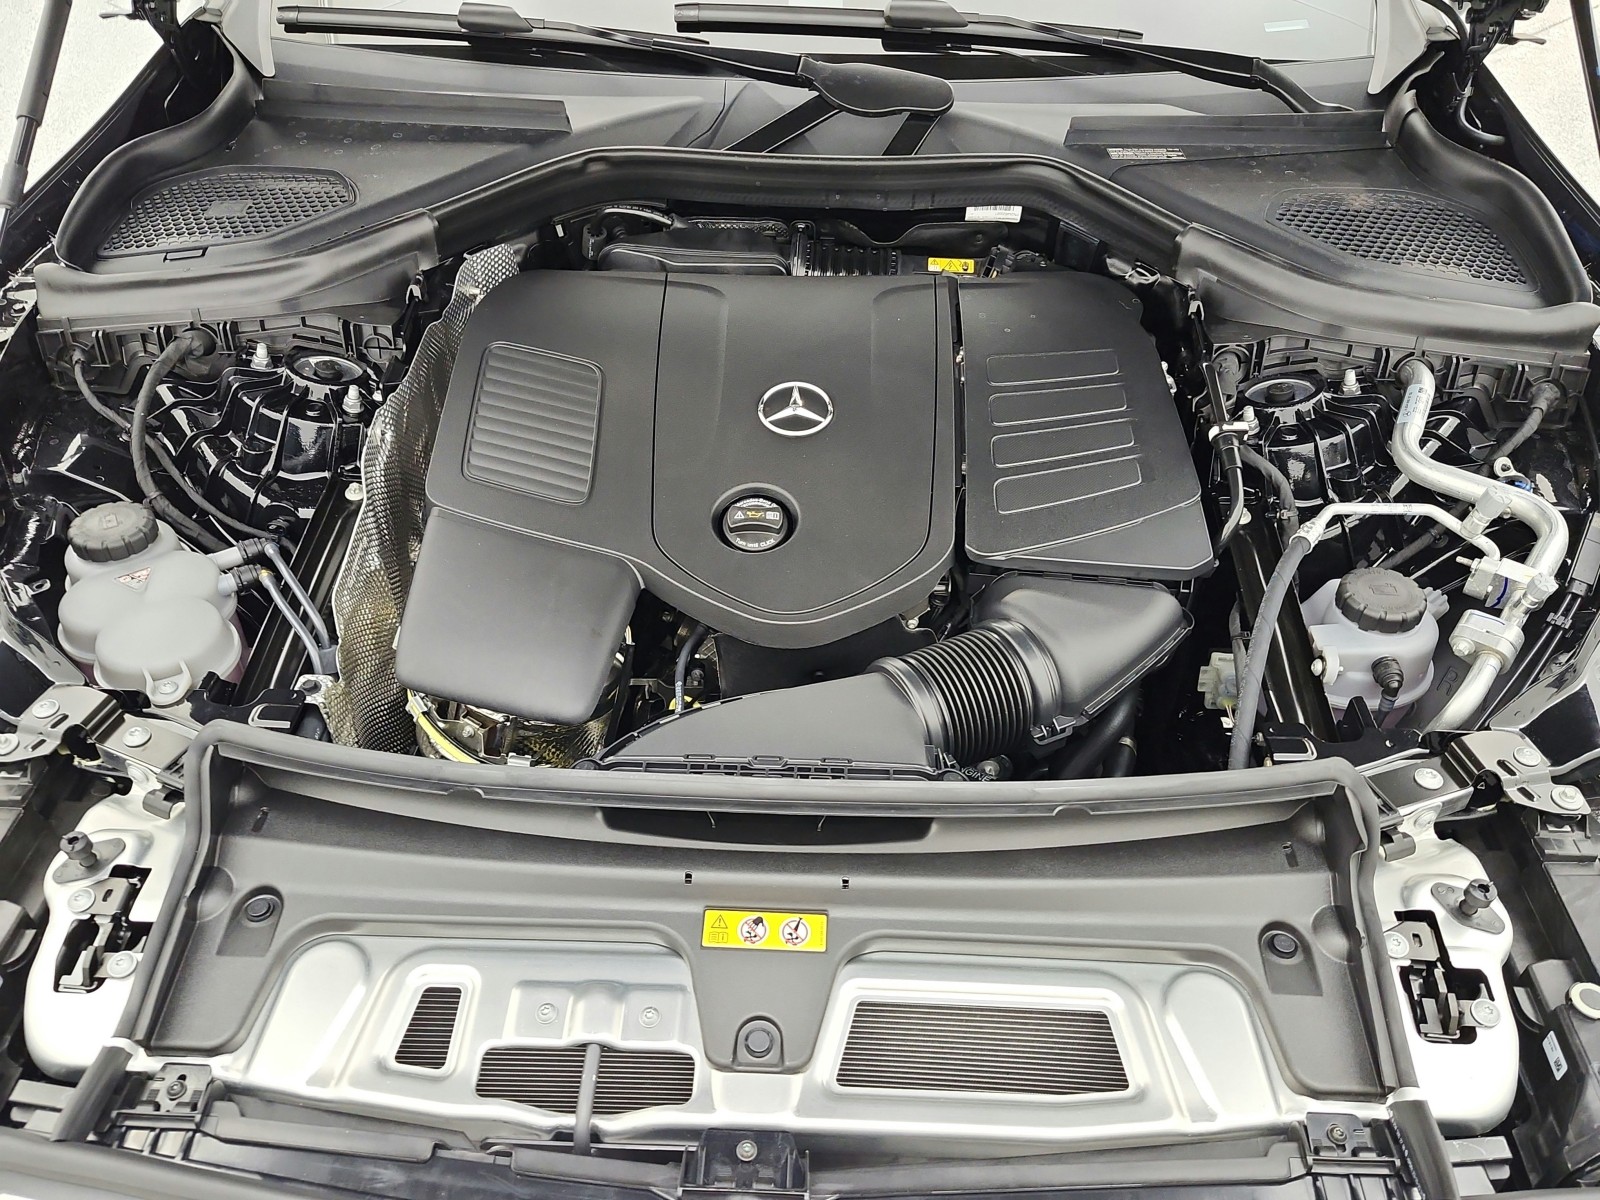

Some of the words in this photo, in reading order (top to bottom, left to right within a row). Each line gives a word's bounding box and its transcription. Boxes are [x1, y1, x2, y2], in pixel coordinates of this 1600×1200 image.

[735, 537, 746, 546] Turn
[759, 538, 776, 547] CLICK
[961, 766, 991, 782] NGINE
